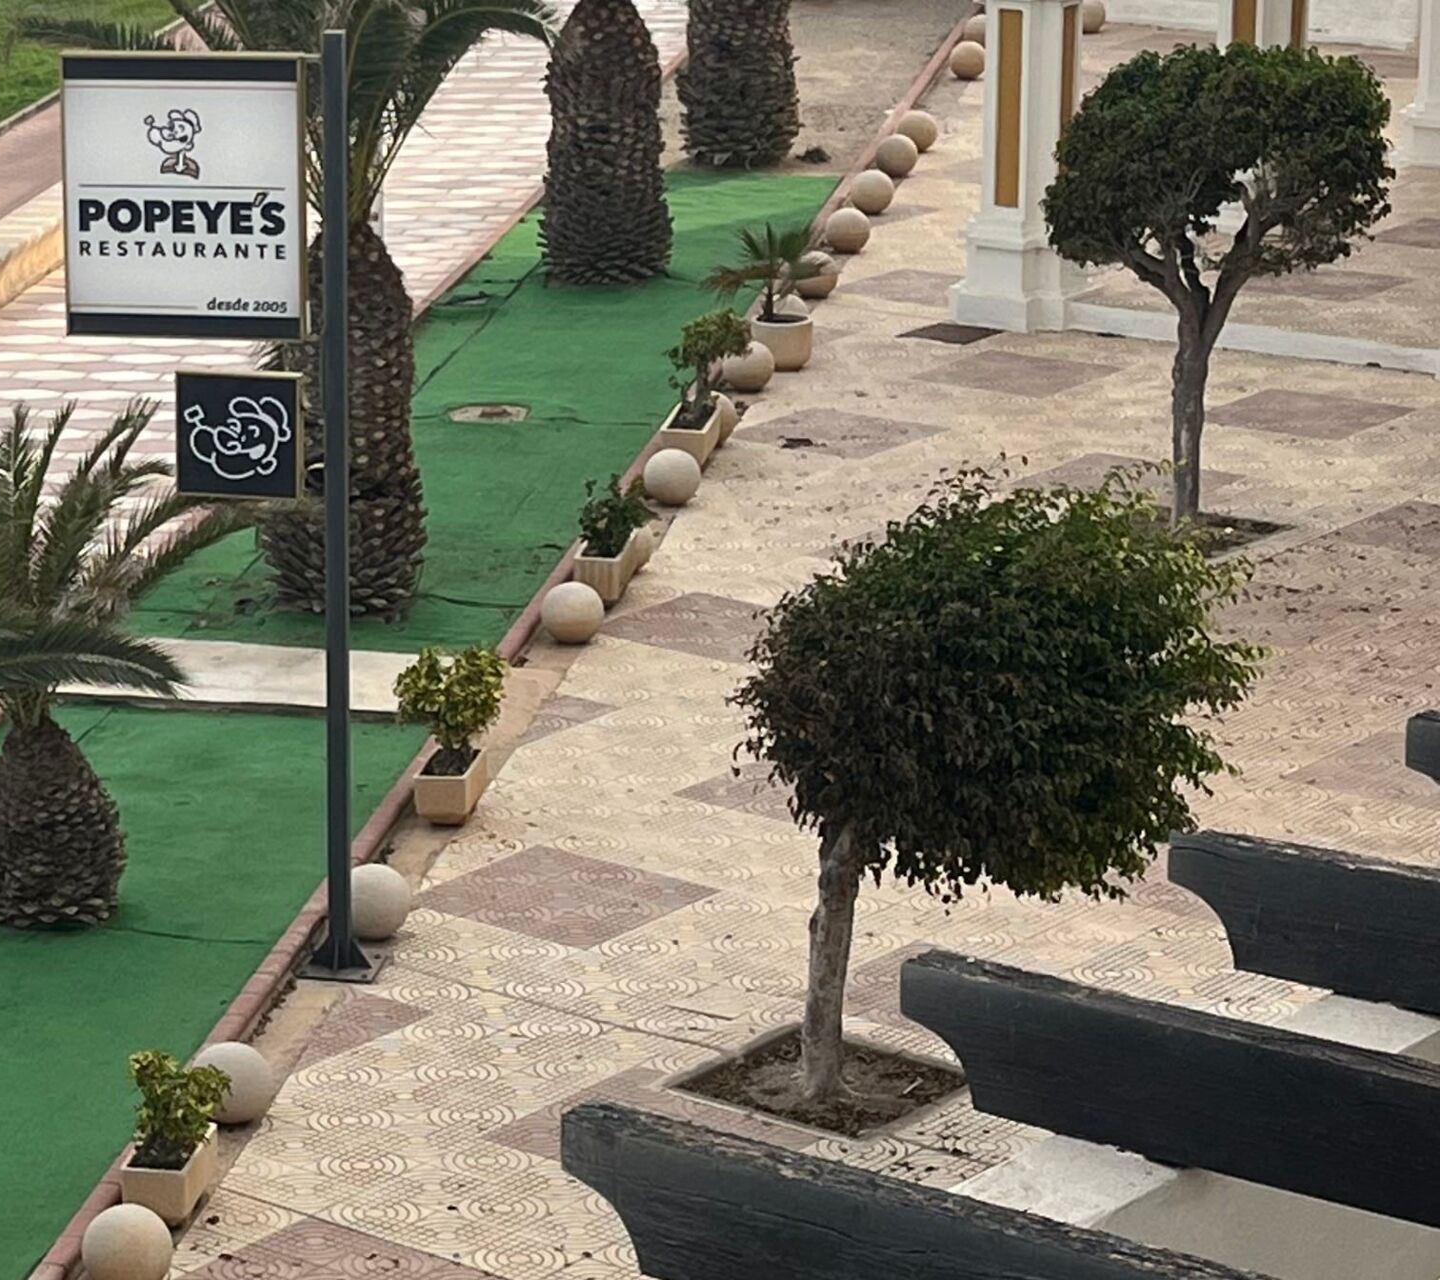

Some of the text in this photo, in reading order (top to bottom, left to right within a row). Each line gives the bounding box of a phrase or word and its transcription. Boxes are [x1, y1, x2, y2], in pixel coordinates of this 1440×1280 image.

[79, 240, 287, 260] RESTAURANTE
[206, 297, 288, 314] desde 2005
